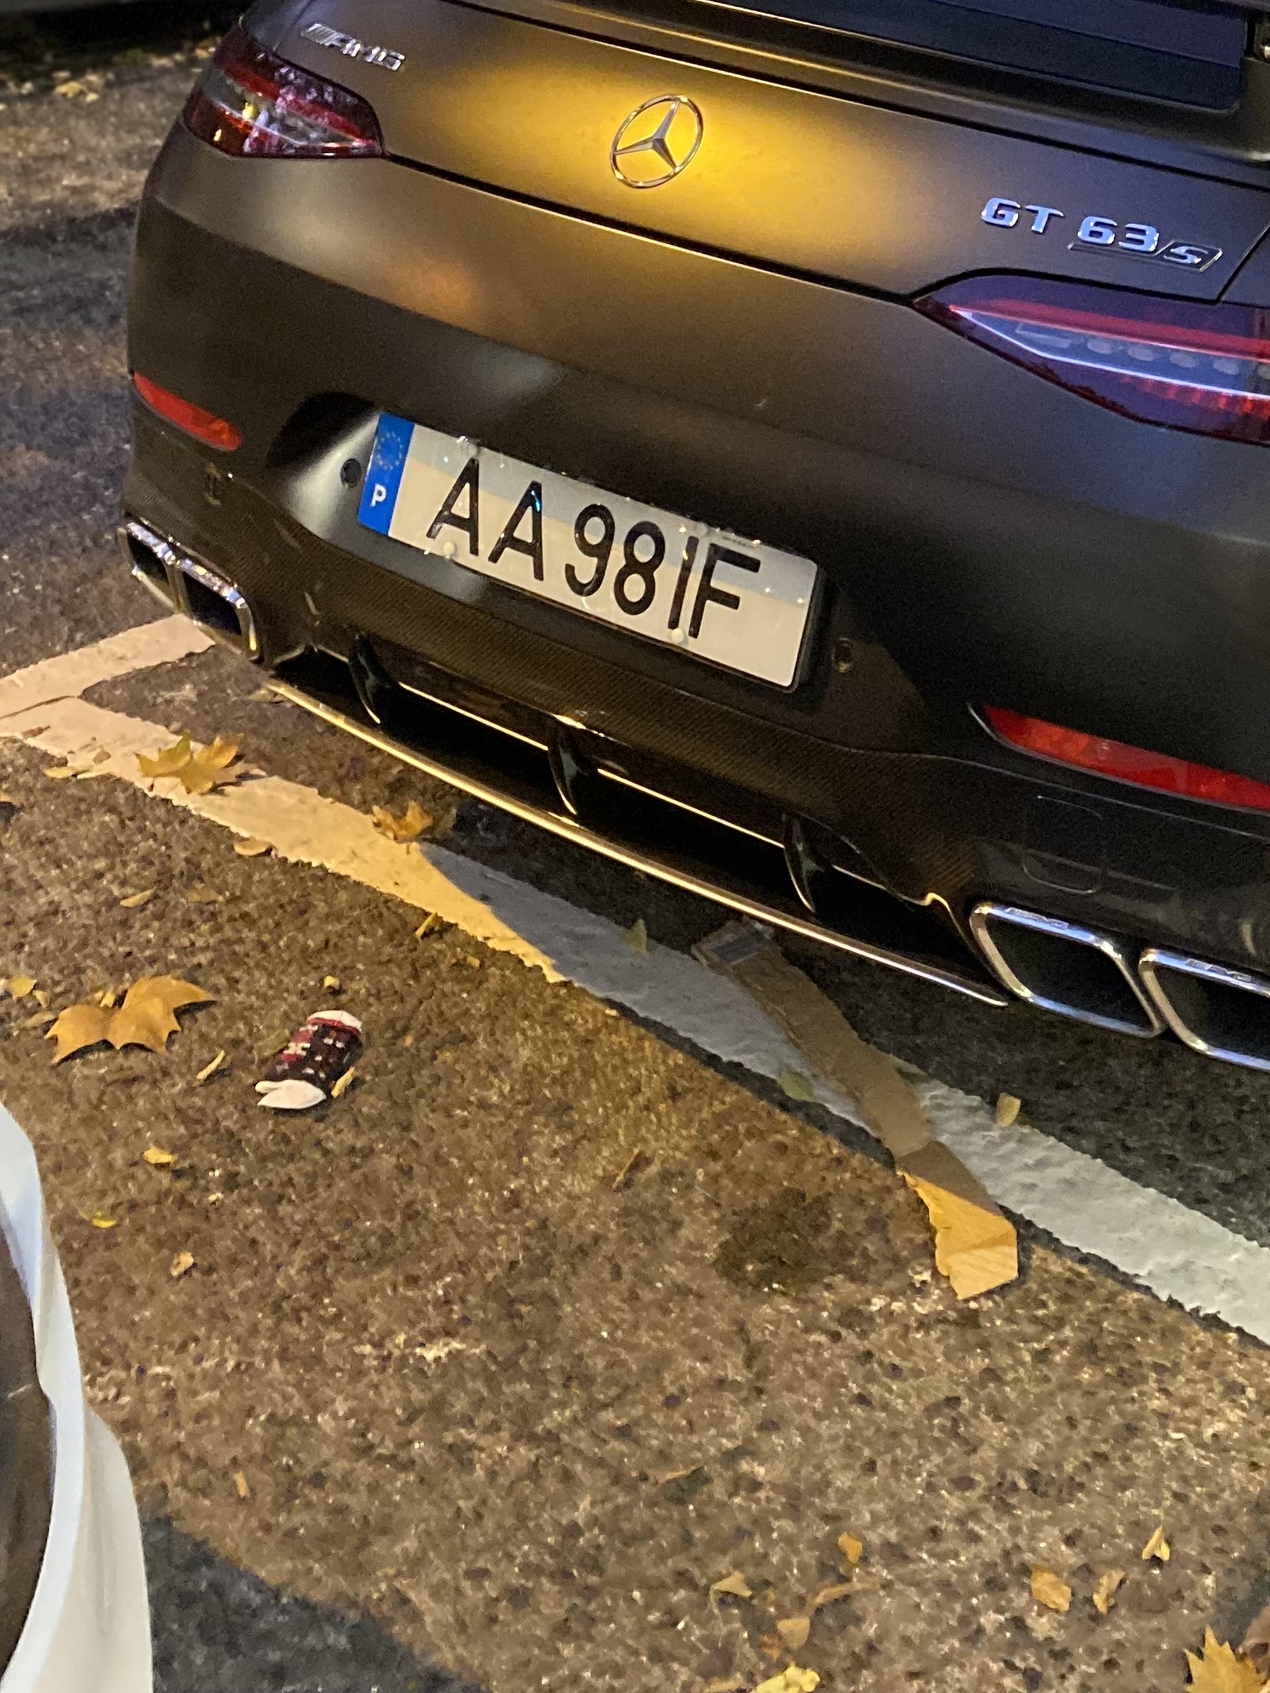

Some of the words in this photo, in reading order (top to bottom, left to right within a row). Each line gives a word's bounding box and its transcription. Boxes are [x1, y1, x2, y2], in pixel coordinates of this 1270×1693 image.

[981, 197, 1065, 234] GT
[1077, 215, 1160, 253] 63
[370, 483, 387, 508] P
